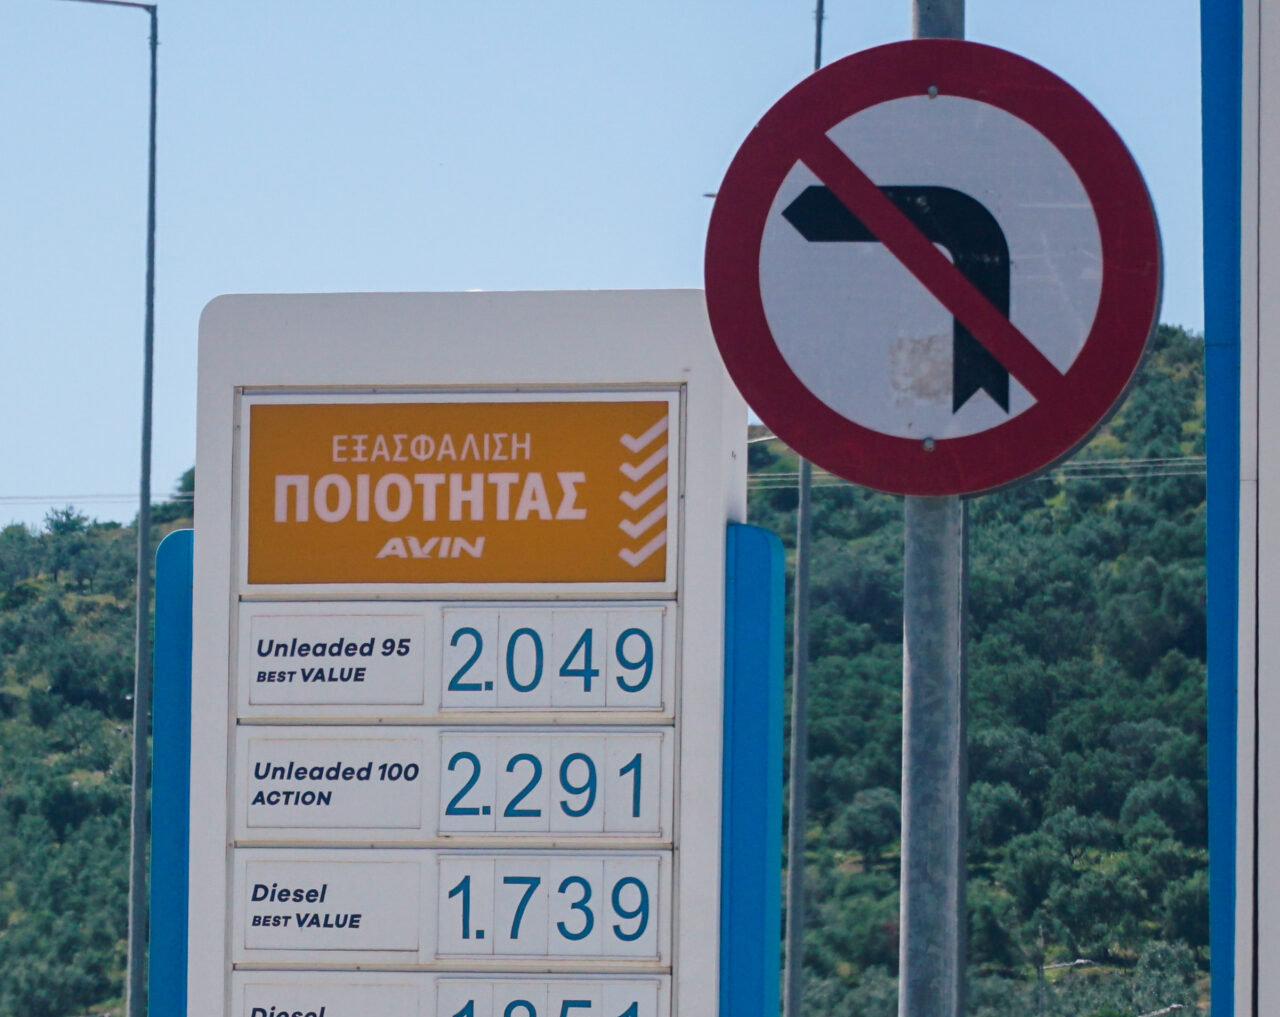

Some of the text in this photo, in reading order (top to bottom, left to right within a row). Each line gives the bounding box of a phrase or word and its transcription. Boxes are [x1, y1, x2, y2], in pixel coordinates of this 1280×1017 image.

[331, 432, 532, 463] ΕΞΑΣΦΑΛΙΣΗ
[273, 471, 588, 523] ΠΟΙΟΤΗΤΑΣ
[376, 536, 486, 559] AVIN
[256, 637, 411, 658] Unleaded 95
[447, 626, 654, 693] 2.049
[256, 667, 367, 684] BEST VALUE
[253, 761, 420, 782] Unleaded 100
[444, 751, 642, 818] 2.291
[251, 790, 333, 806] ACTION
[251, 883, 327, 904] Diesel
[447, 875, 650, 942] 1.739
[251, 912, 362, 929] BEST VALUE
